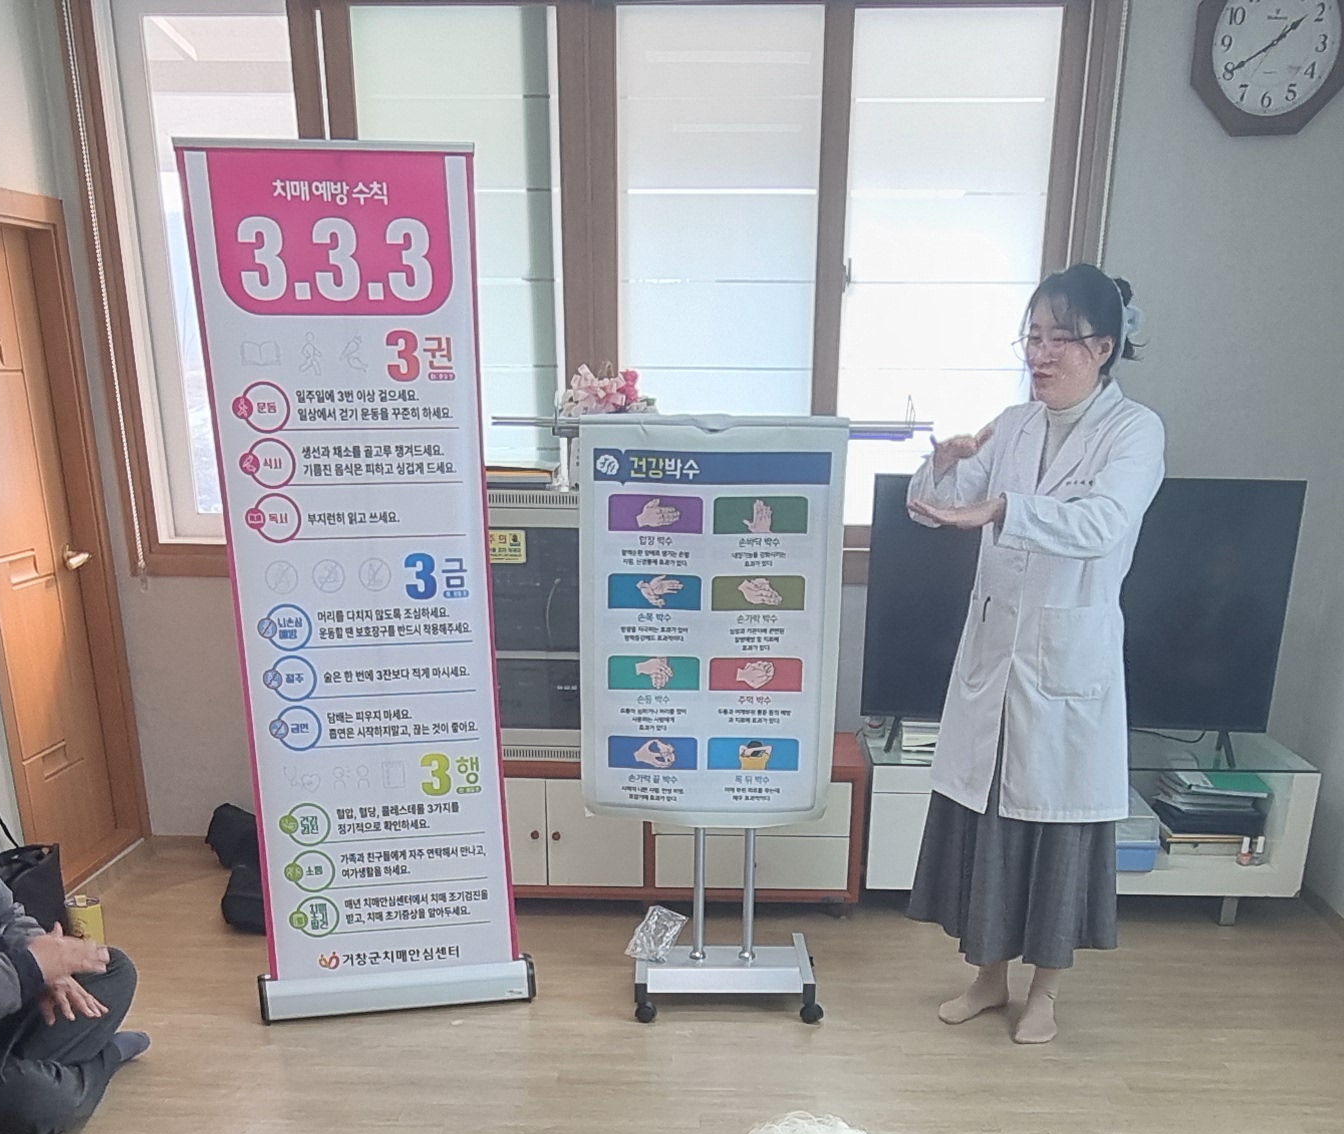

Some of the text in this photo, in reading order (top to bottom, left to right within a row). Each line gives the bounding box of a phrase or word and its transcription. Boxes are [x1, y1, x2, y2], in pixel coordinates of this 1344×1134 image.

[1228, 7, 1246, 25] 10
[1314, 2, 1325, 22] 2
[1221, 35, 1233, 51] 9
[1315, 34, 1328, 53] 3
[1222, 62, 1235, 81] 8
[1305, 61, 1316, 79] 4
[1239, 84, 1249, 102] 7
[1261, 92, 1271, 108] 6
[1285, 84, 1297, 101] 5
[272, 180, 388, 205] 치매 예방 수칙
[237, 216, 433, 301] 3.3.3
[386, 330, 453, 382] 3권
[296, 389, 419, 403] 일주일에 3번 이상 걸으세요.
[298, 407, 453, 421] 일상에서 걷기 운동을 꾸준히 하세요.
[302, 445, 444, 459] 생선과 채소를 골고루 챙겨드세요.
[304, 462, 456, 476] 기름진 음식은 피하고 싱겁게 드세요.
[630, 457, 700, 479] 건강박수
[308, 512, 400, 525] 부지런히 읽고 쓰세요.
[764, 538, 780, 546] 박수
[404, 553, 467, 599] 3금
[317, 607, 449, 623] 머리를 다치지 않도록 조심하세요.
[656, 613, 671, 622] 박수
[763, 615, 778, 623] 박수
[319, 627, 343, 639] 운동할
[356, 625, 395, 637] 보호장구를
[398, 624, 421, 636] 반드시
[424, 623, 472, 635] 착용해주세요.
[324, 666, 470, 683] 술은 한 번에 3잔보다 적게 마시세요.
[756, 696, 771, 705] 박수
[327, 709, 412, 724] 담배는 피우지 마세요.
[329, 728, 354, 739] 흡연은
[413, 724, 429, 735] 끊는
[432, 723, 448, 734] 것이
[451, 721, 478, 733] 좋아요.
[421, 753, 479, 796] 3행
[336, 802, 459, 820] 혈압, 혈당, 콜레스테롤 3가지를
[338, 819, 430, 834] 정기적으로 확인하세요.
[340, 845, 486, 864] 가족과 친구들에게 자주 연락해서 만나고,
[342, 865, 410, 879] 여가생활을 하세요.
[344, 890, 488, 909] 매년 치매안심센터에서 치매 조기검진을
[346, 906, 470, 924] 받고, 치매 초기증상을 알아두세요.
[342, 946, 460, 966] 거창군치매안심센터
